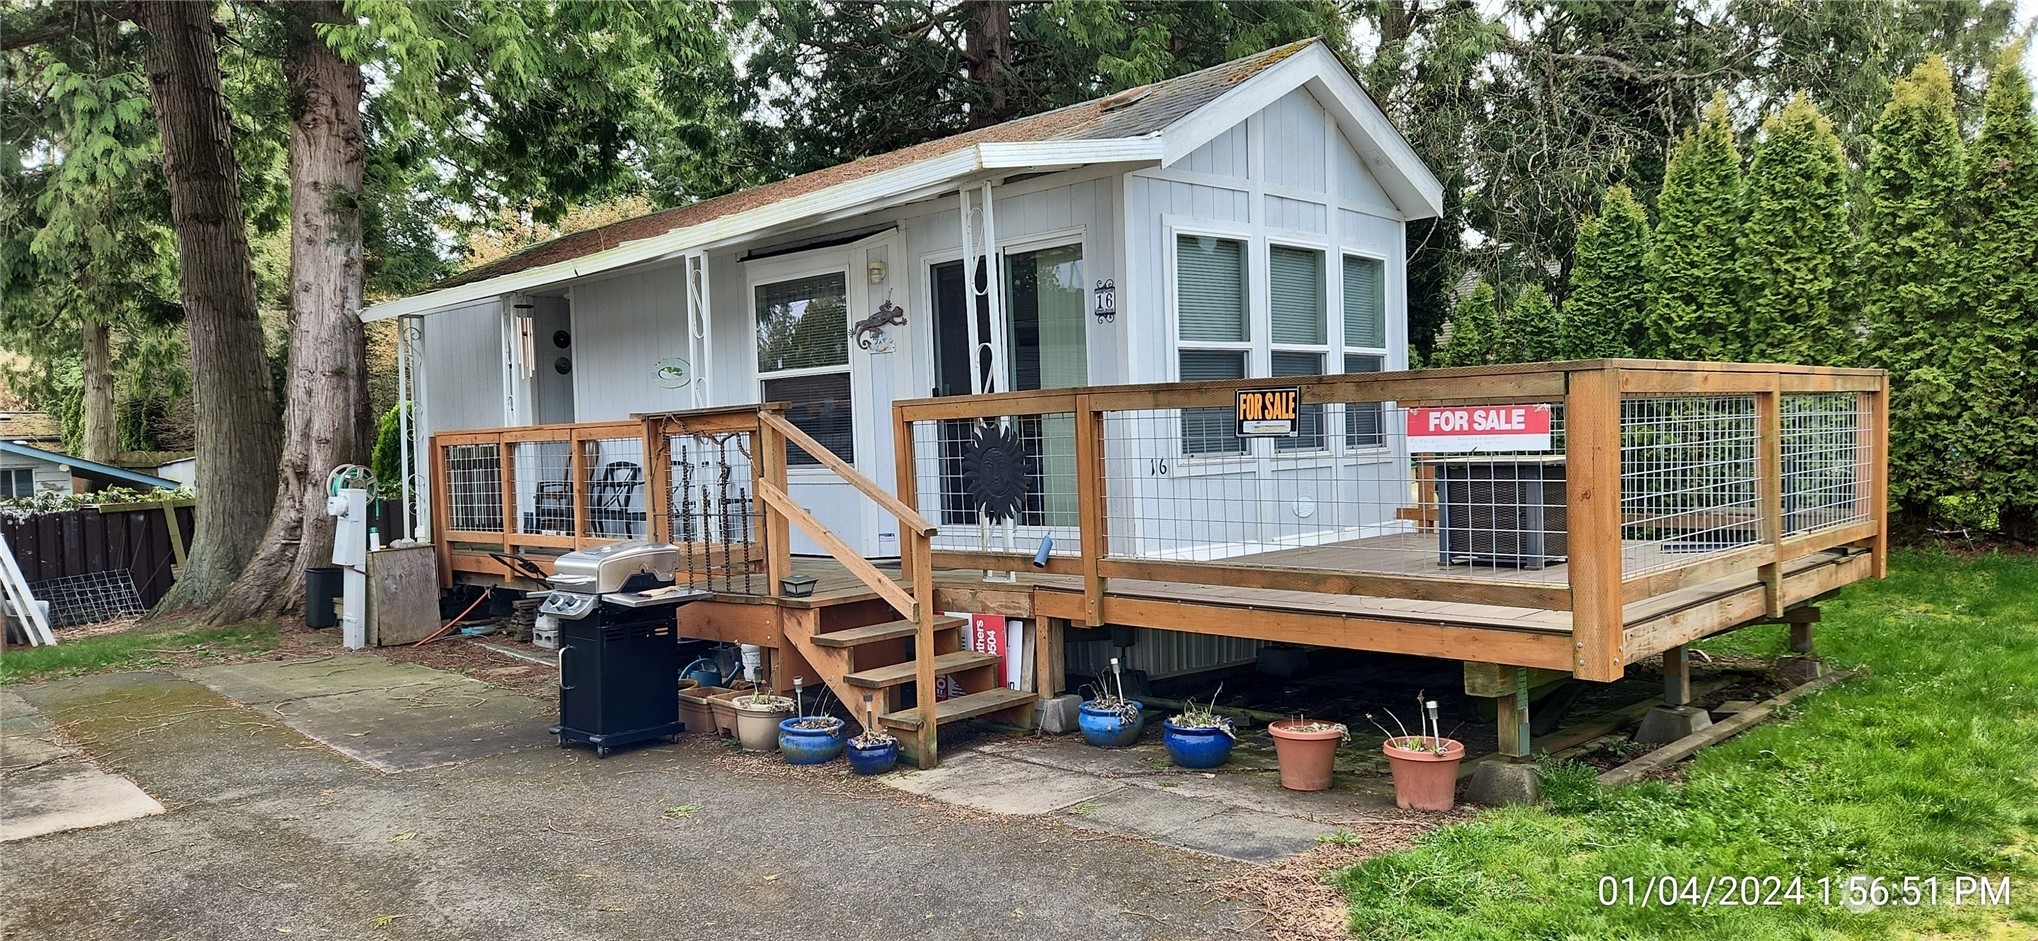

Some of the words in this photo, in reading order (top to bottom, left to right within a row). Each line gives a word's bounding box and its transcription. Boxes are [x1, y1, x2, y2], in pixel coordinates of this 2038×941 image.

[1096, 293, 1113, 310] 16
[1239, 393, 1263, 420] FOR
[1264, 392, 1296, 420] SALE
[1428, 410, 1472, 432] FOR
[1473, 408, 1526, 431] SALE
[1150, 458, 1168, 476] 16
